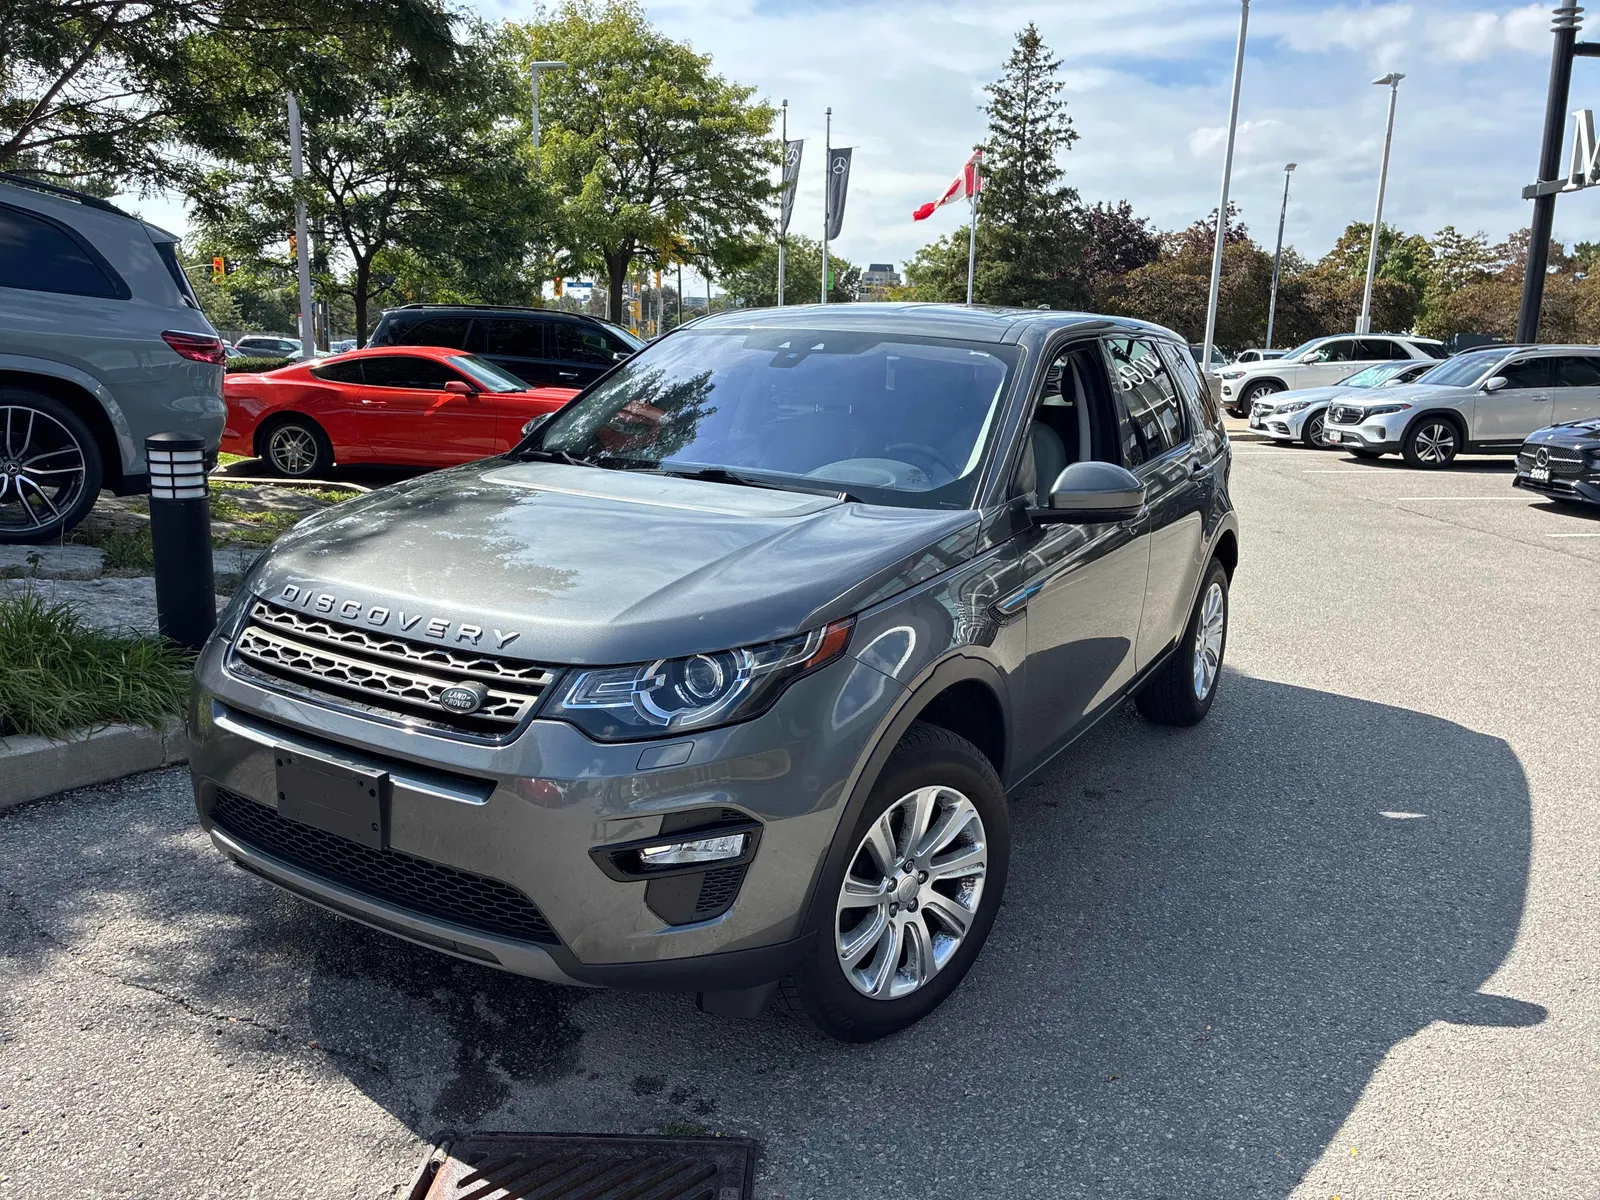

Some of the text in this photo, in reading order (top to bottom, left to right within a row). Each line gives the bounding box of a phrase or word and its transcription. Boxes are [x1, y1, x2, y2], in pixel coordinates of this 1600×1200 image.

[1530, 468, 1549, 480] 2024
[281, 584, 520, 649] DISCOVERY
[448, 691, 467, 700] LAND
[448, 699, 471, 708] ROVER
